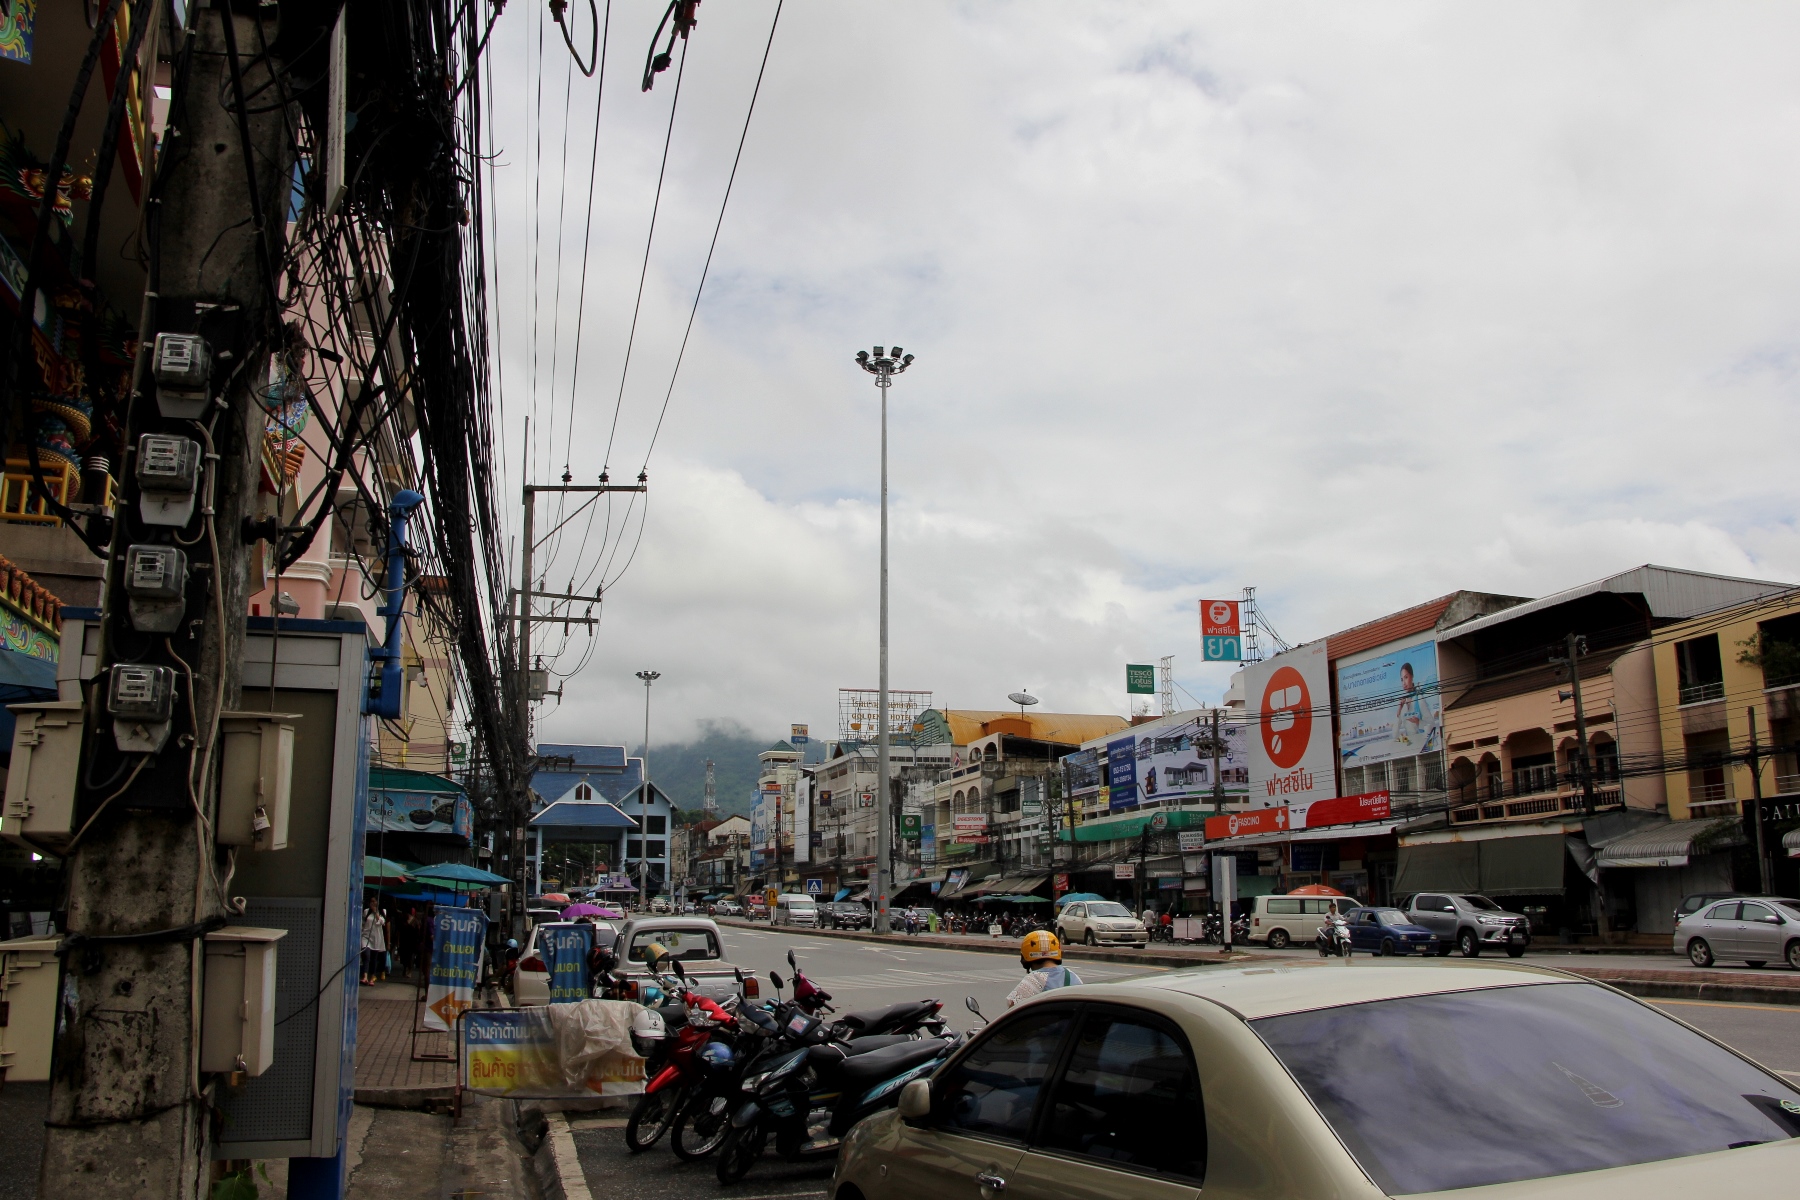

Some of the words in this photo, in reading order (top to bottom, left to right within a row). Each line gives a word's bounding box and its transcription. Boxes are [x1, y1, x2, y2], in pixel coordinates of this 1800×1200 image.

[1207, 638, 1238, 659] ยา
[1266, 767, 1313, 796] ฟาสซิโน
[1238, 816, 1260, 827] FASCINO
[440, 914, 482, 934] ร้านค้า
